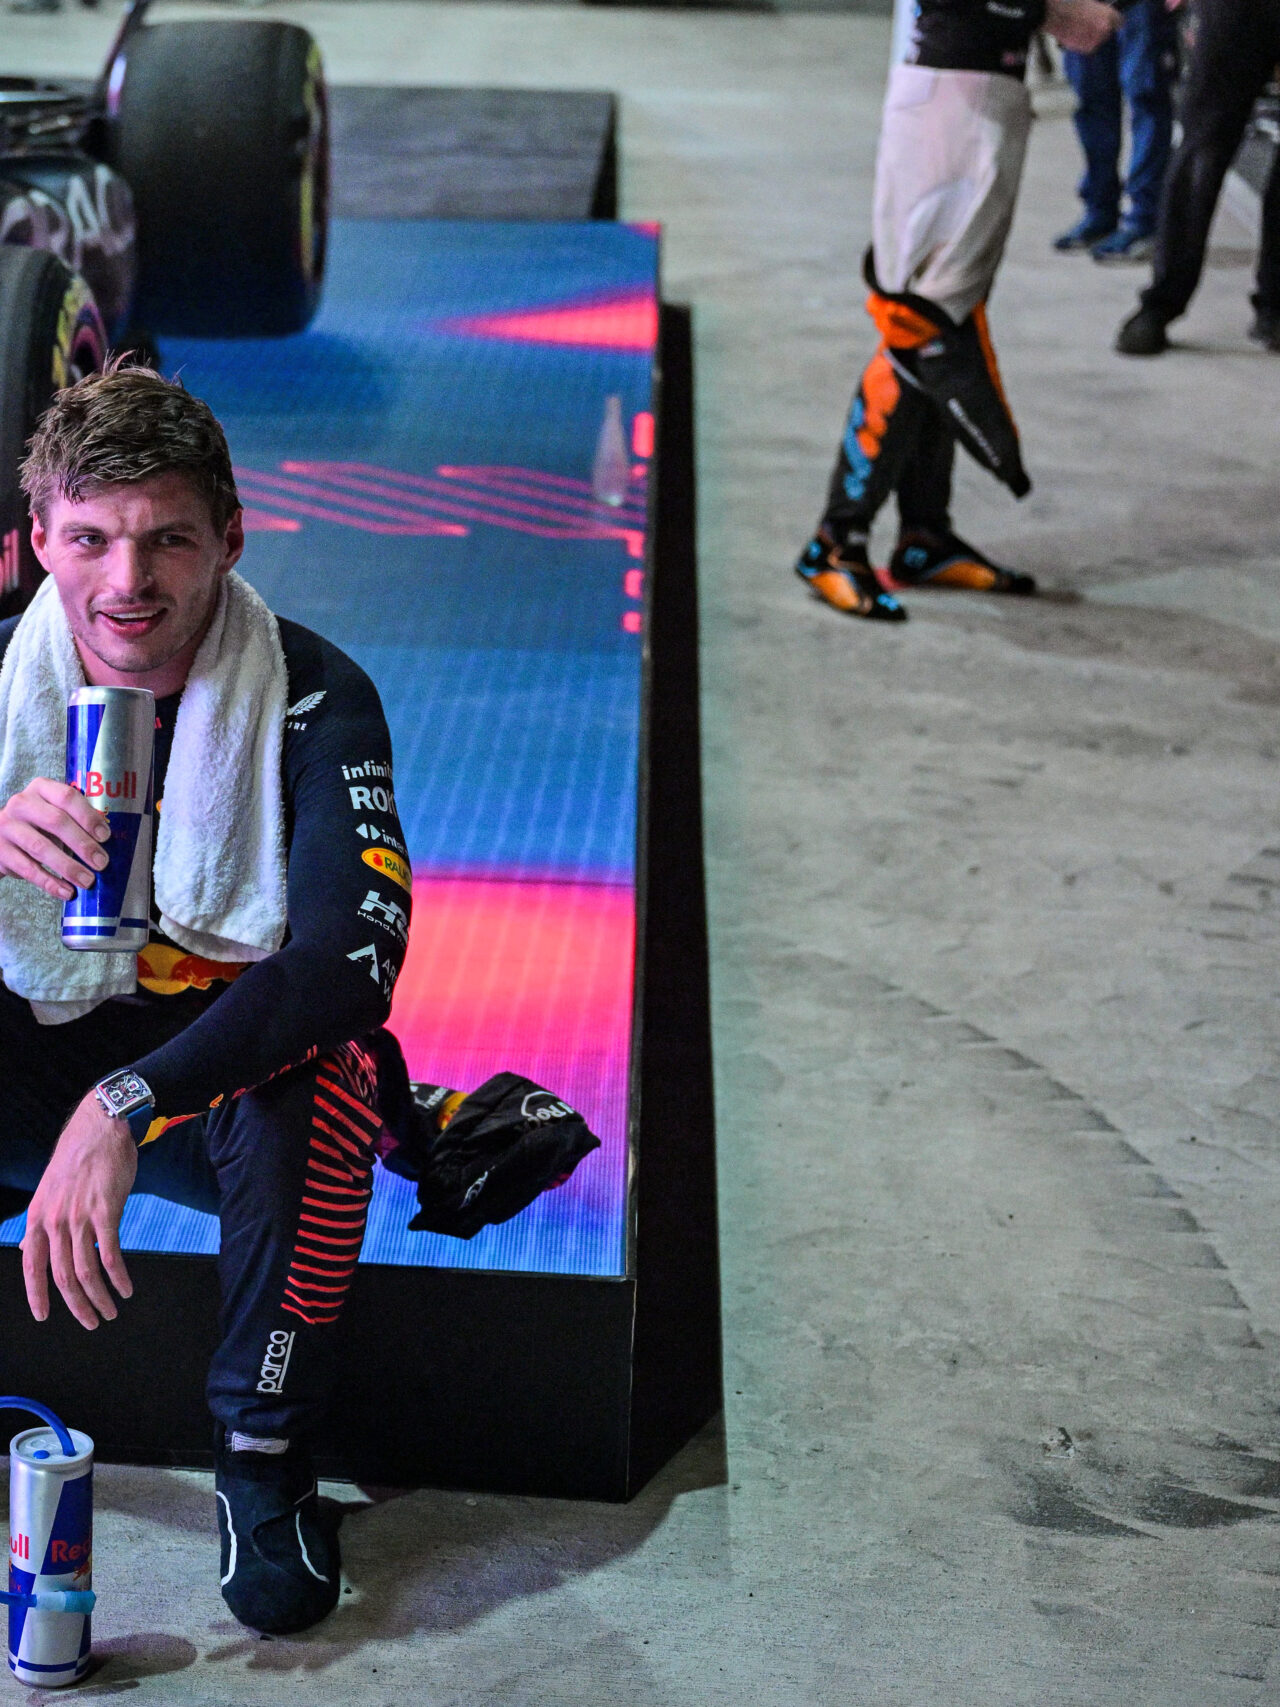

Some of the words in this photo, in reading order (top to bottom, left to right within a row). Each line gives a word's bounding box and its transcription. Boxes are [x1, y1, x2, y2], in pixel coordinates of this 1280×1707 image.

[85, 770, 137, 799] Bull
[357, 910, 396, 937] Honda
[256, 1330, 291, 1394] parco
[9, 1532, 30, 1561] ull
